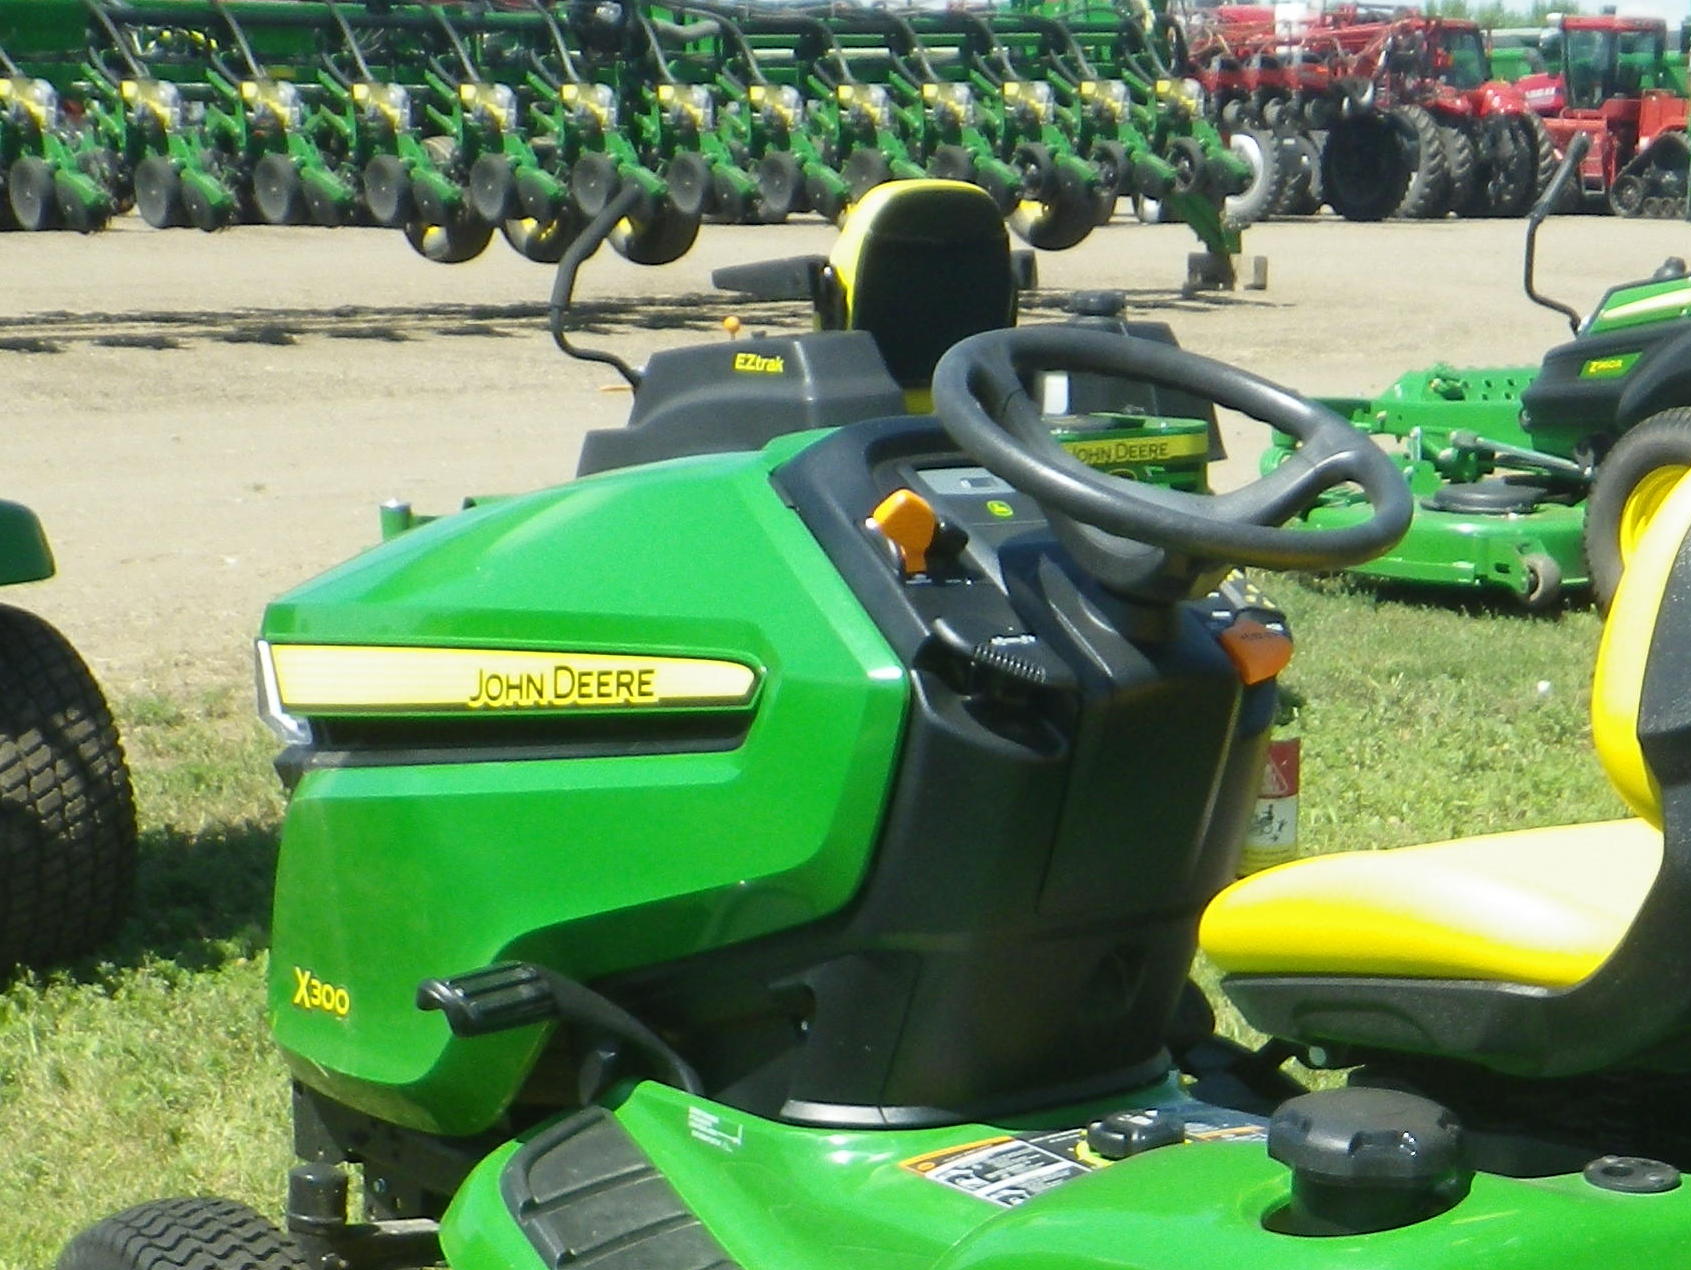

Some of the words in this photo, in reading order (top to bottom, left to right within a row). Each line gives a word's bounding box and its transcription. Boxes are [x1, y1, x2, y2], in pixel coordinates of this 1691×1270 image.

[734, 352, 784, 373] EZtrak
[1114, 442, 1169, 461] DEERE
[469, 667, 544, 702] JOHN
[553, 664, 656, 699] DEERE
[293, 965, 350, 1016] X300
